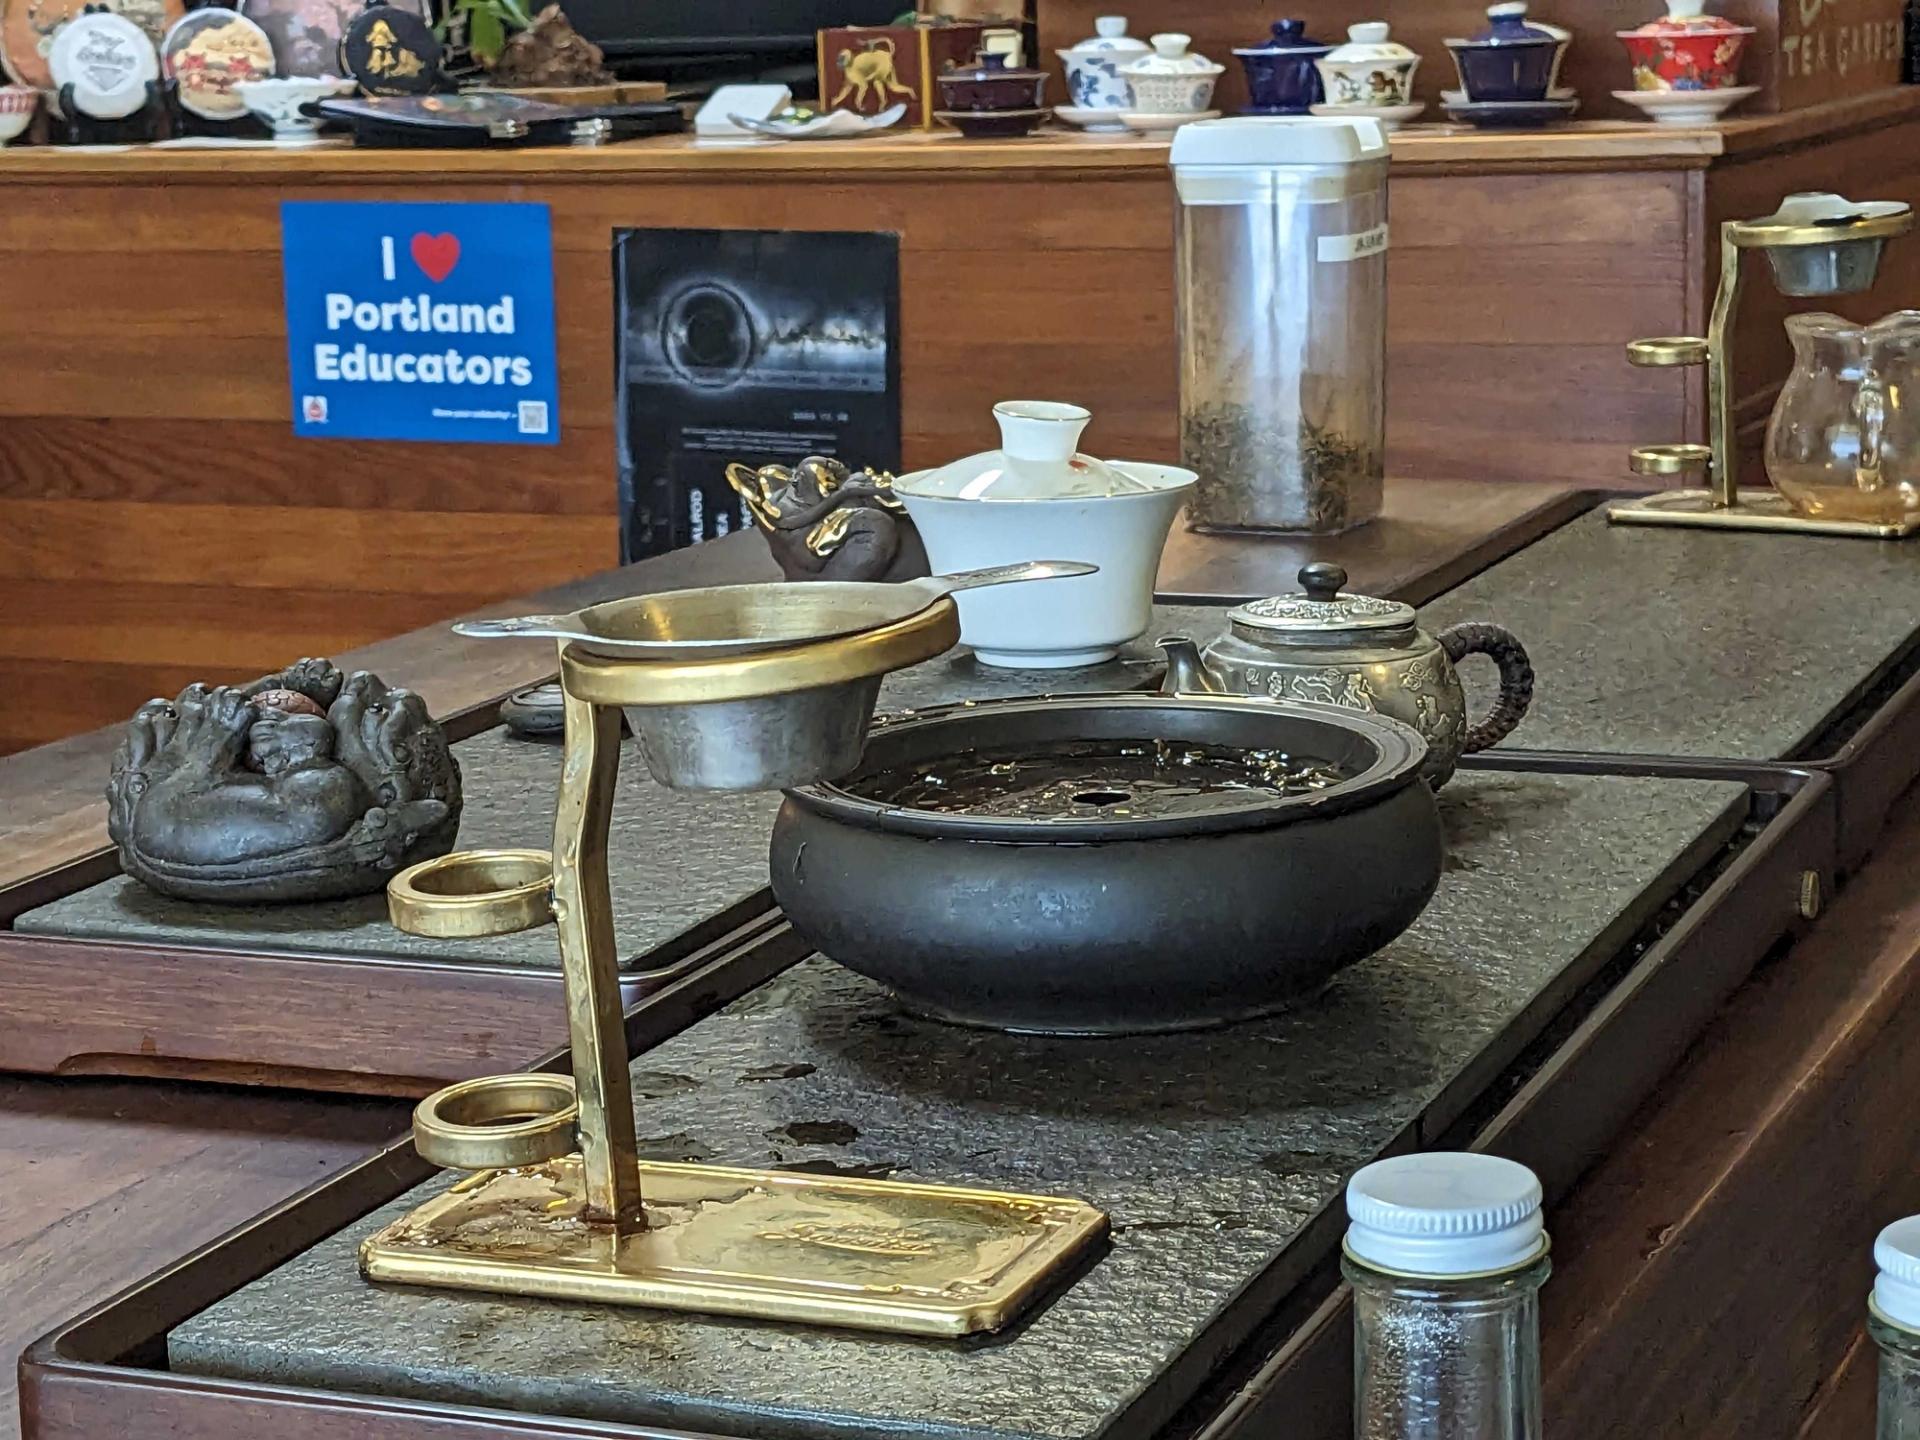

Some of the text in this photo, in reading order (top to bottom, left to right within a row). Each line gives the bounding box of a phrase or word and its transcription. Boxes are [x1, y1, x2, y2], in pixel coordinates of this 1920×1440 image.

[1782, 28, 1827, 77] TEA
[381, 236, 396, 281] I
[325, 293, 515, 334] Portland
[314, 343, 533, 386] Educators
